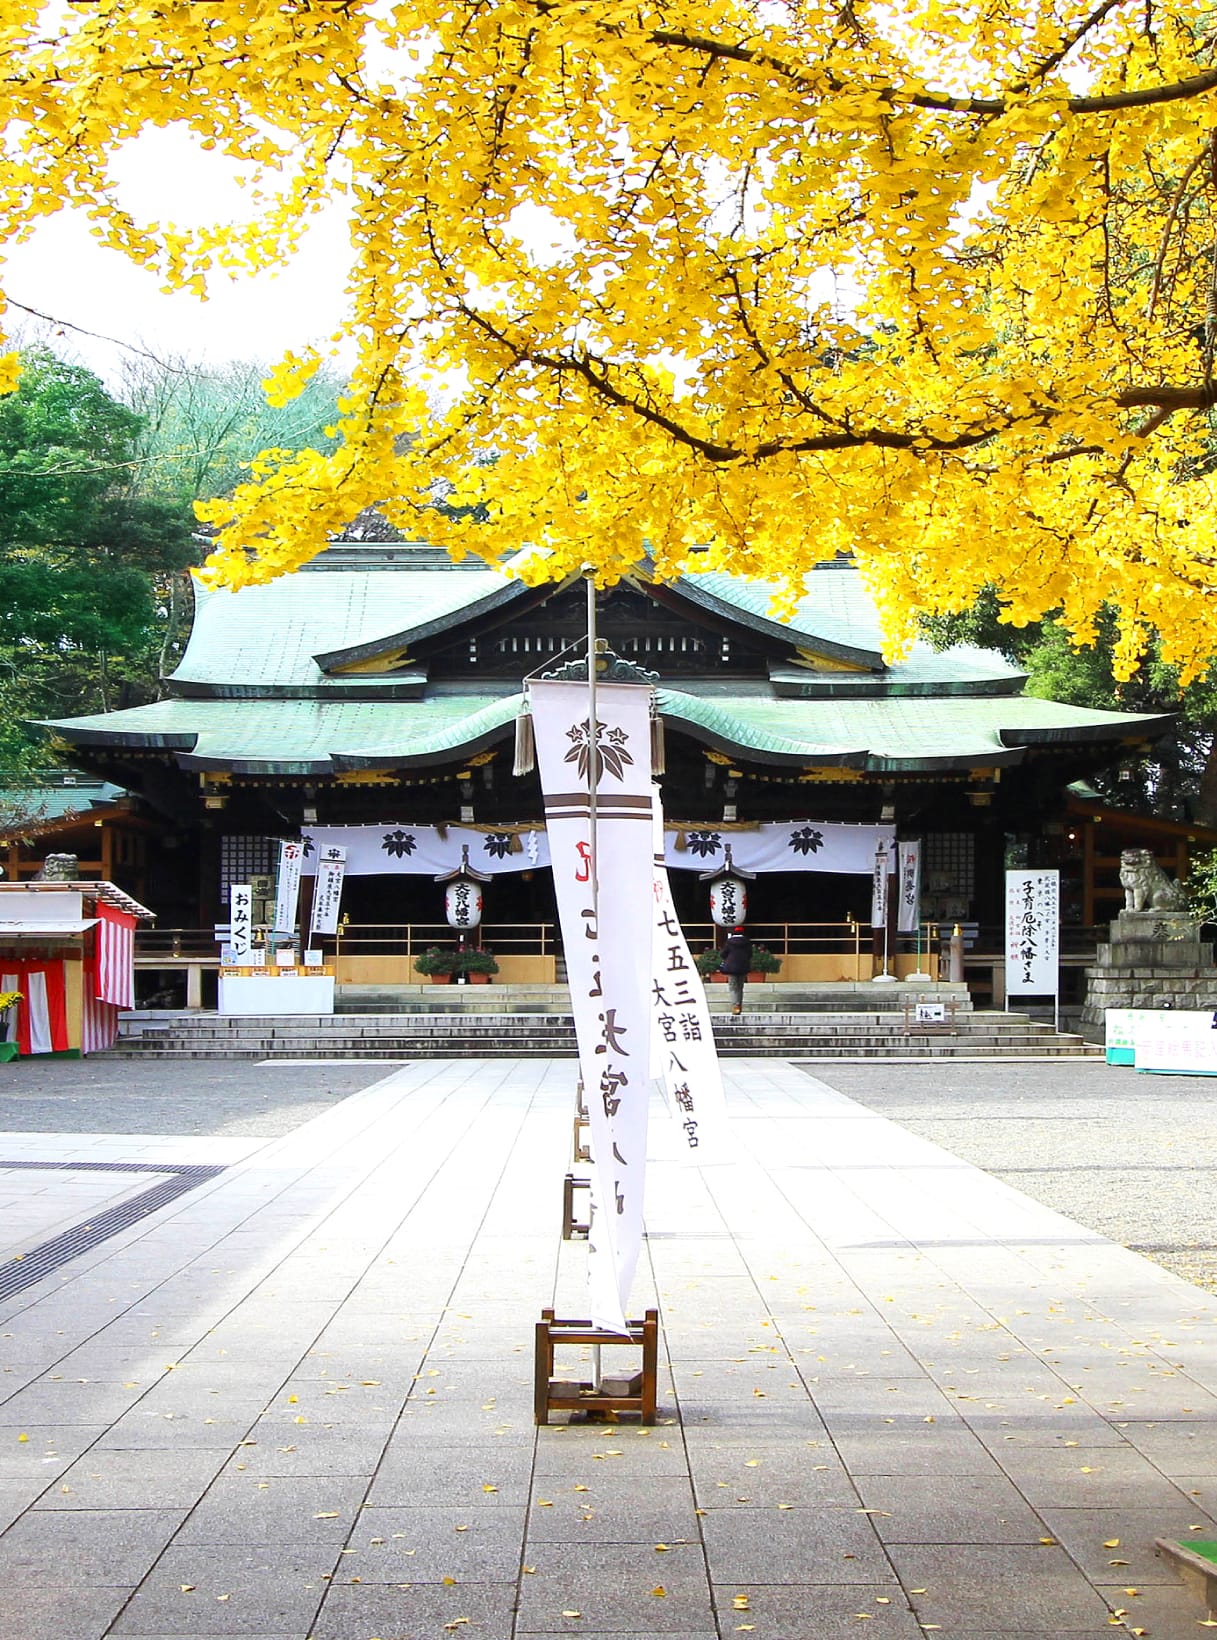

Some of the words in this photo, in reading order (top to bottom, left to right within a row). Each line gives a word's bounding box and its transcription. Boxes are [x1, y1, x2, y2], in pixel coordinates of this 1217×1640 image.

[234, 893, 248, 956] おみくじ
[454, 883, 471, 926] 大宮八幡宮
[720, 881, 736, 924] 大宮八幡宮
[651, 978, 699, 1148] 大宮八幡宮
